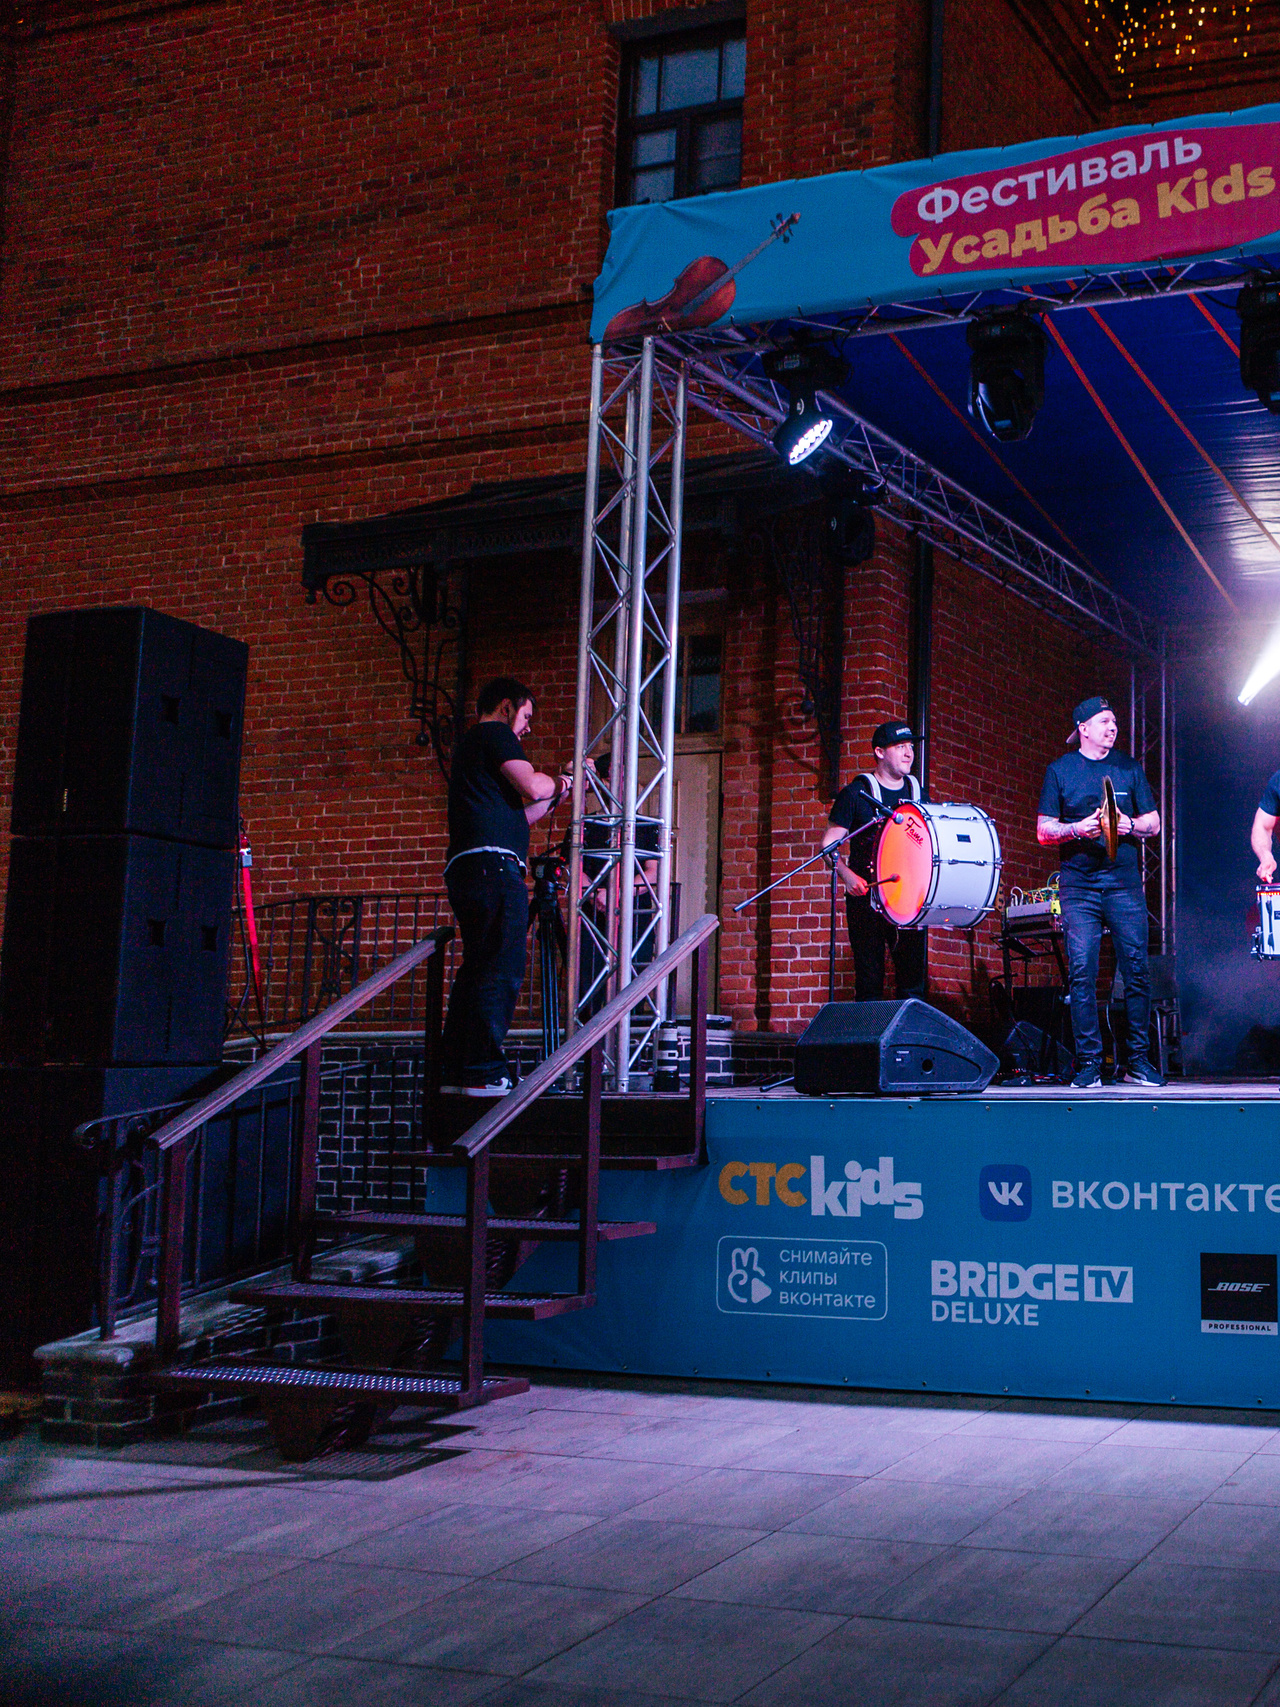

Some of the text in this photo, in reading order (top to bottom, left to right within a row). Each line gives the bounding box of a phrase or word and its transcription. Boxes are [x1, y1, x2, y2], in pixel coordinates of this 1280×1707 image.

[917, 134, 1202, 224] Фестиваль
[917, 162, 1276, 273] Усадьба Kids
[810, 1155, 924, 1220] kids
[779, 1247, 873, 1266] снимайте
[779, 1270, 838, 1286] клипы
[1085, 1266, 1133, 1303] TV
[1208, 1282, 1270, 1293] BOSE
[779, 1291, 876, 1309] вконтакте
[931, 1300, 1040, 1327] DELUXE
[1208, 1322, 1272, 1332] PROFESSIONAL
